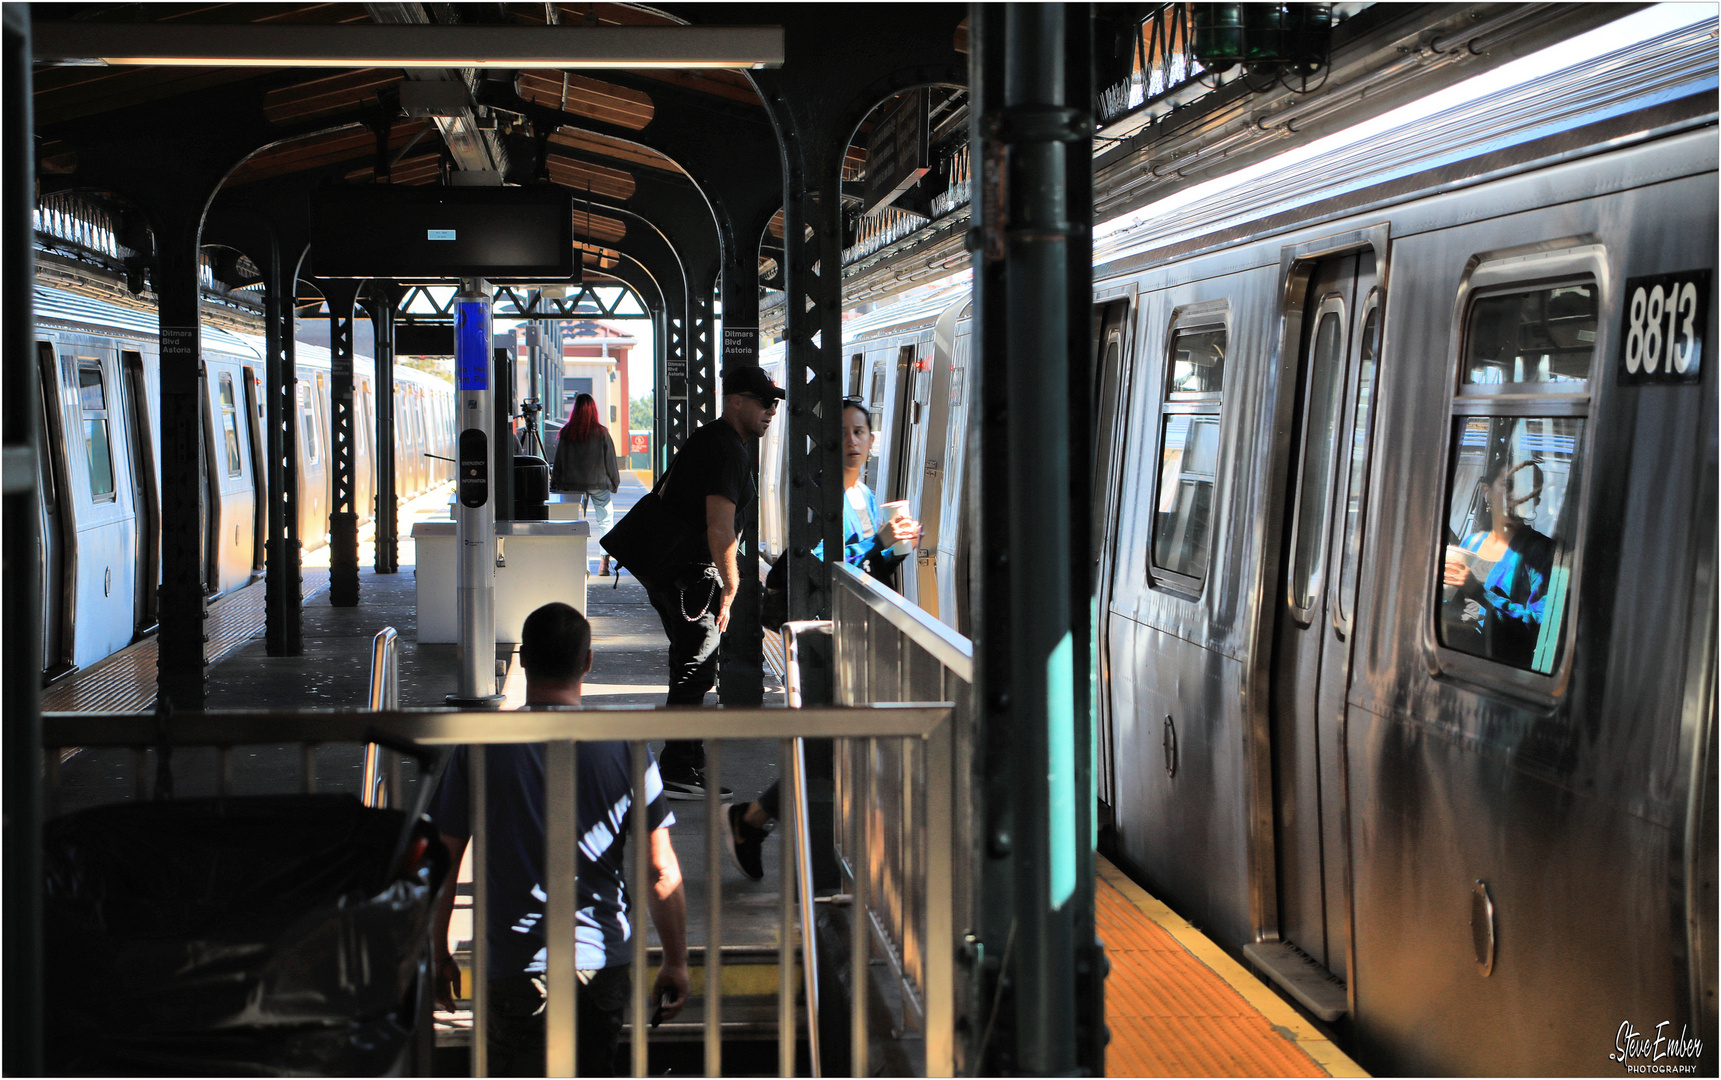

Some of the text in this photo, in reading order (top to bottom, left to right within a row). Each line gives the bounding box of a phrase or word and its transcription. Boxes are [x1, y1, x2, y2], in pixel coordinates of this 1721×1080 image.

[1626, 282, 1697, 374] 8813
[725, 330, 754, 338] Ditmars
[162, 346, 191, 354] Astoria
